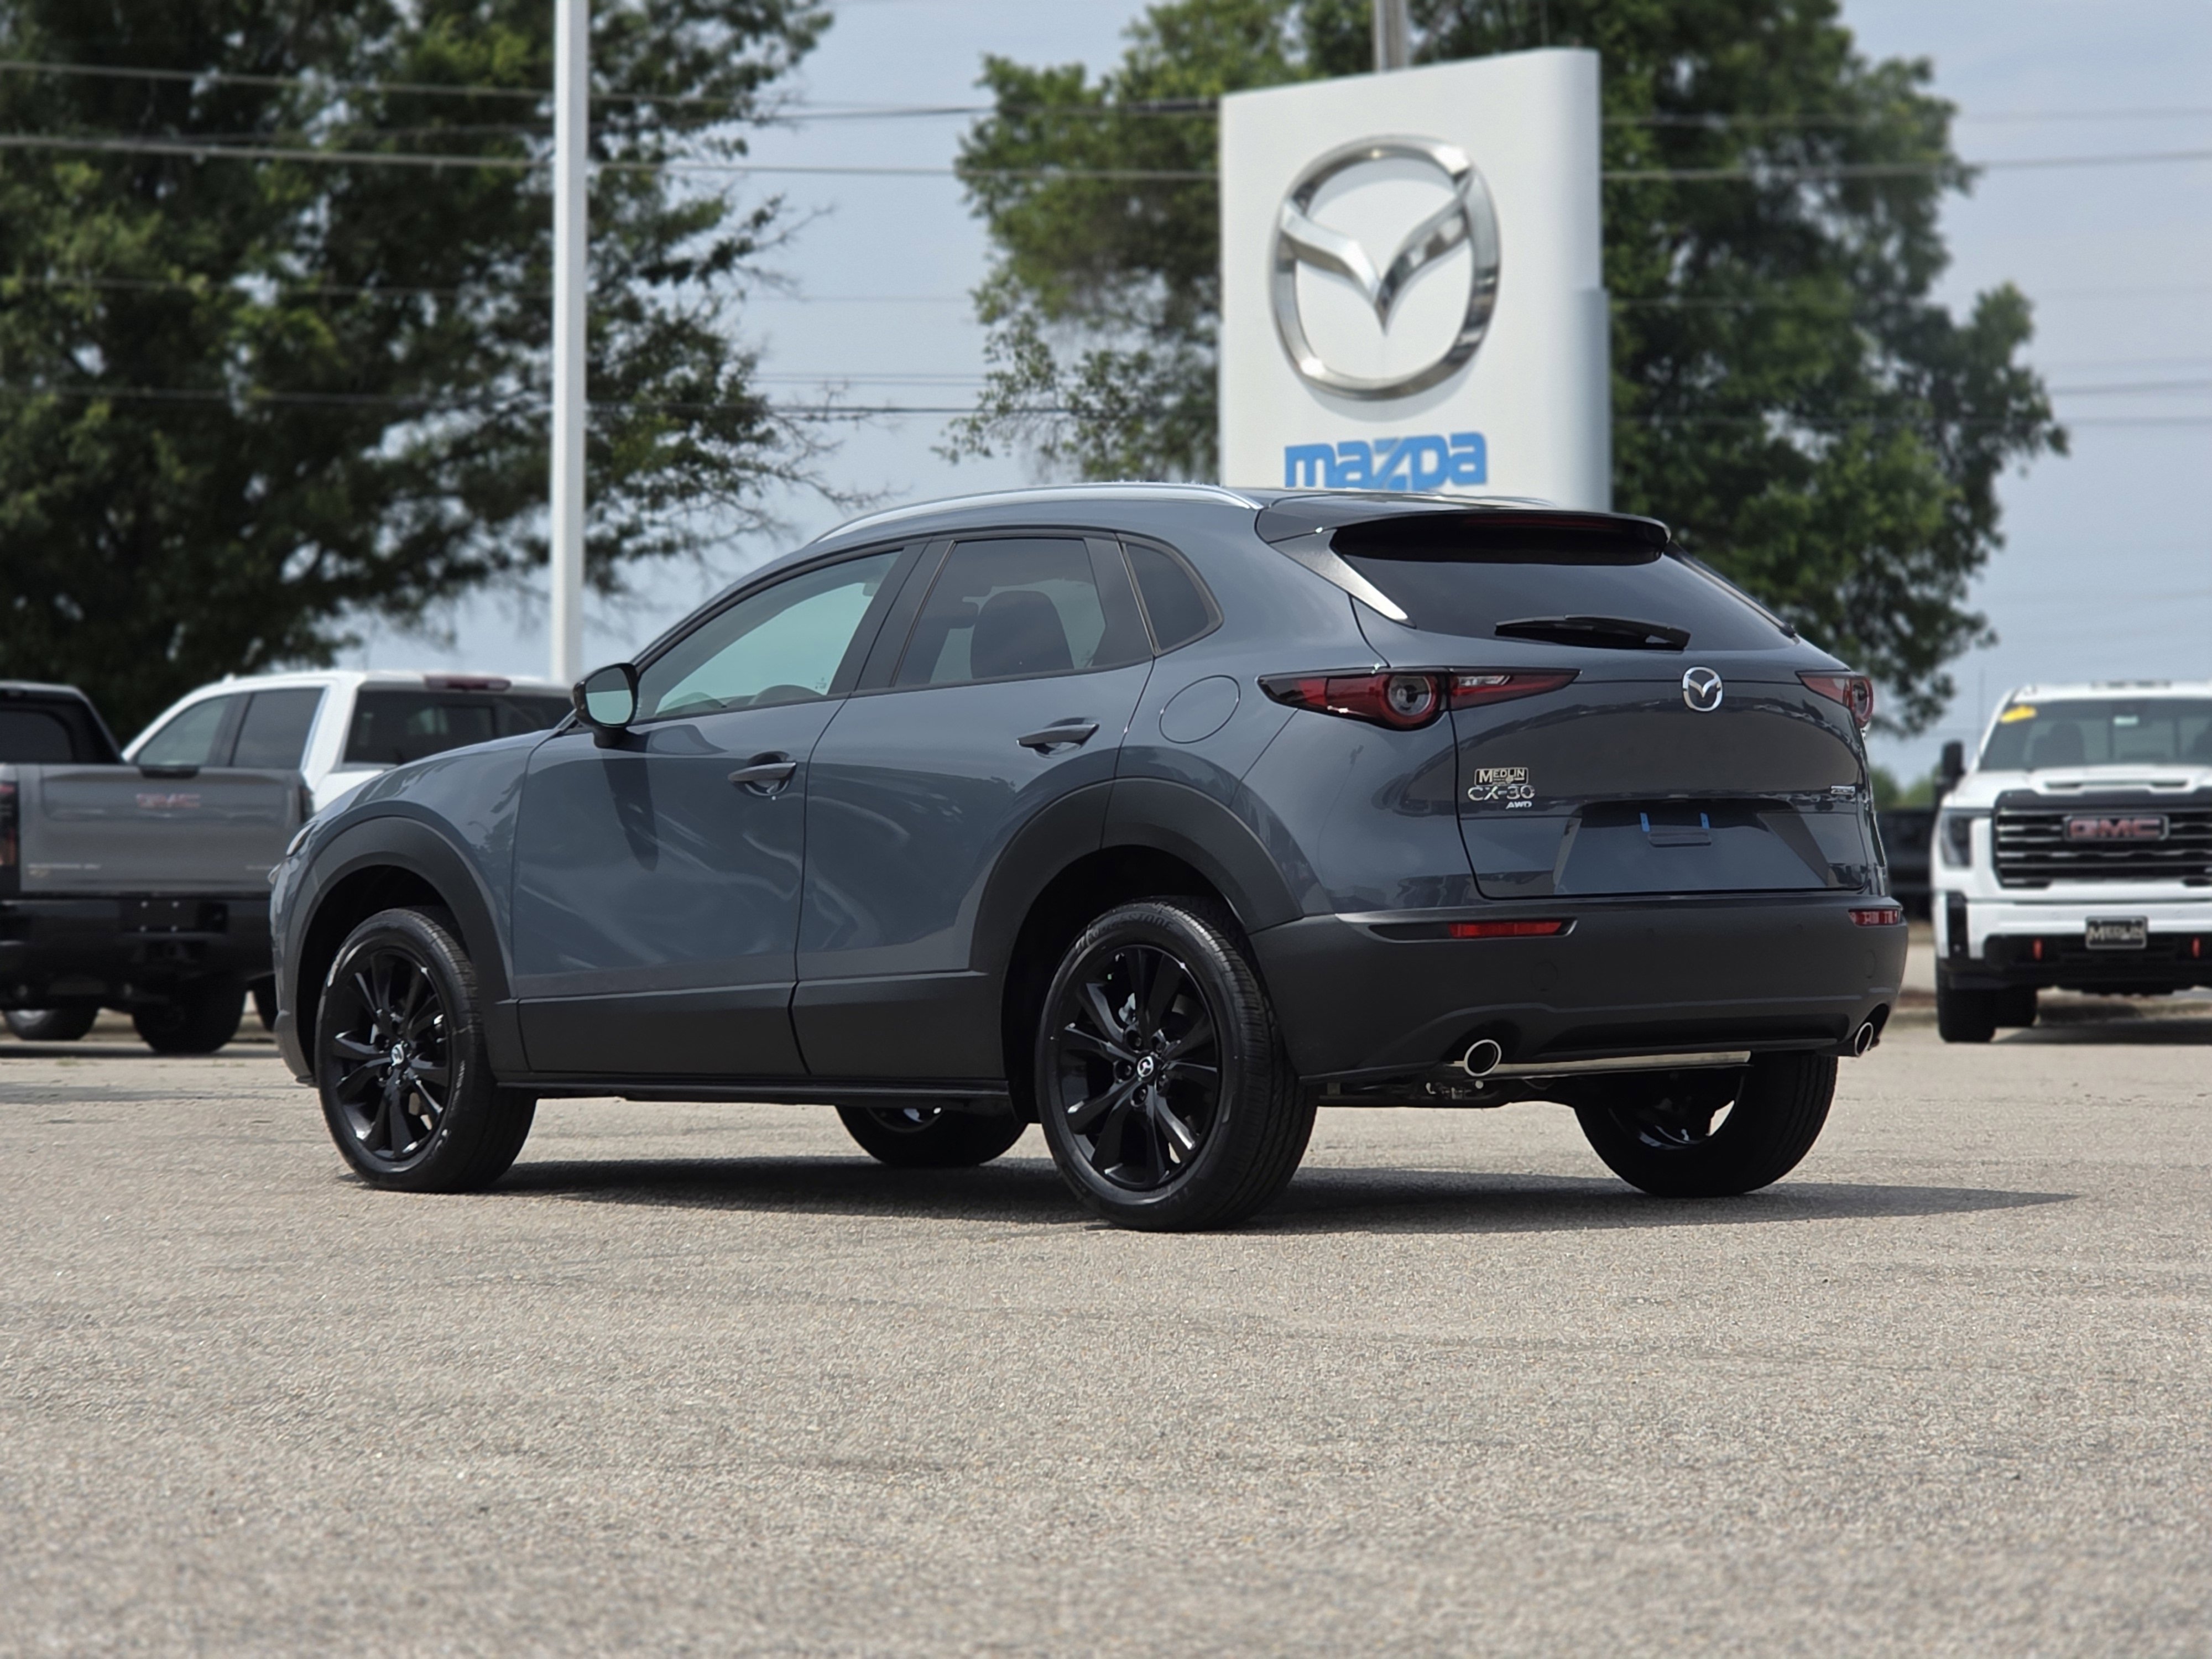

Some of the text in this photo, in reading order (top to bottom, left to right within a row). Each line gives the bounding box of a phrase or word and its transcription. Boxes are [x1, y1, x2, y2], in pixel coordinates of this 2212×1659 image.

[1285, 432, 1487, 491] mazda
[1479, 769, 1525, 783] MEDLIN
[1468, 785, 1535, 801] CX-30
[2069, 819, 2161, 837] GMC
